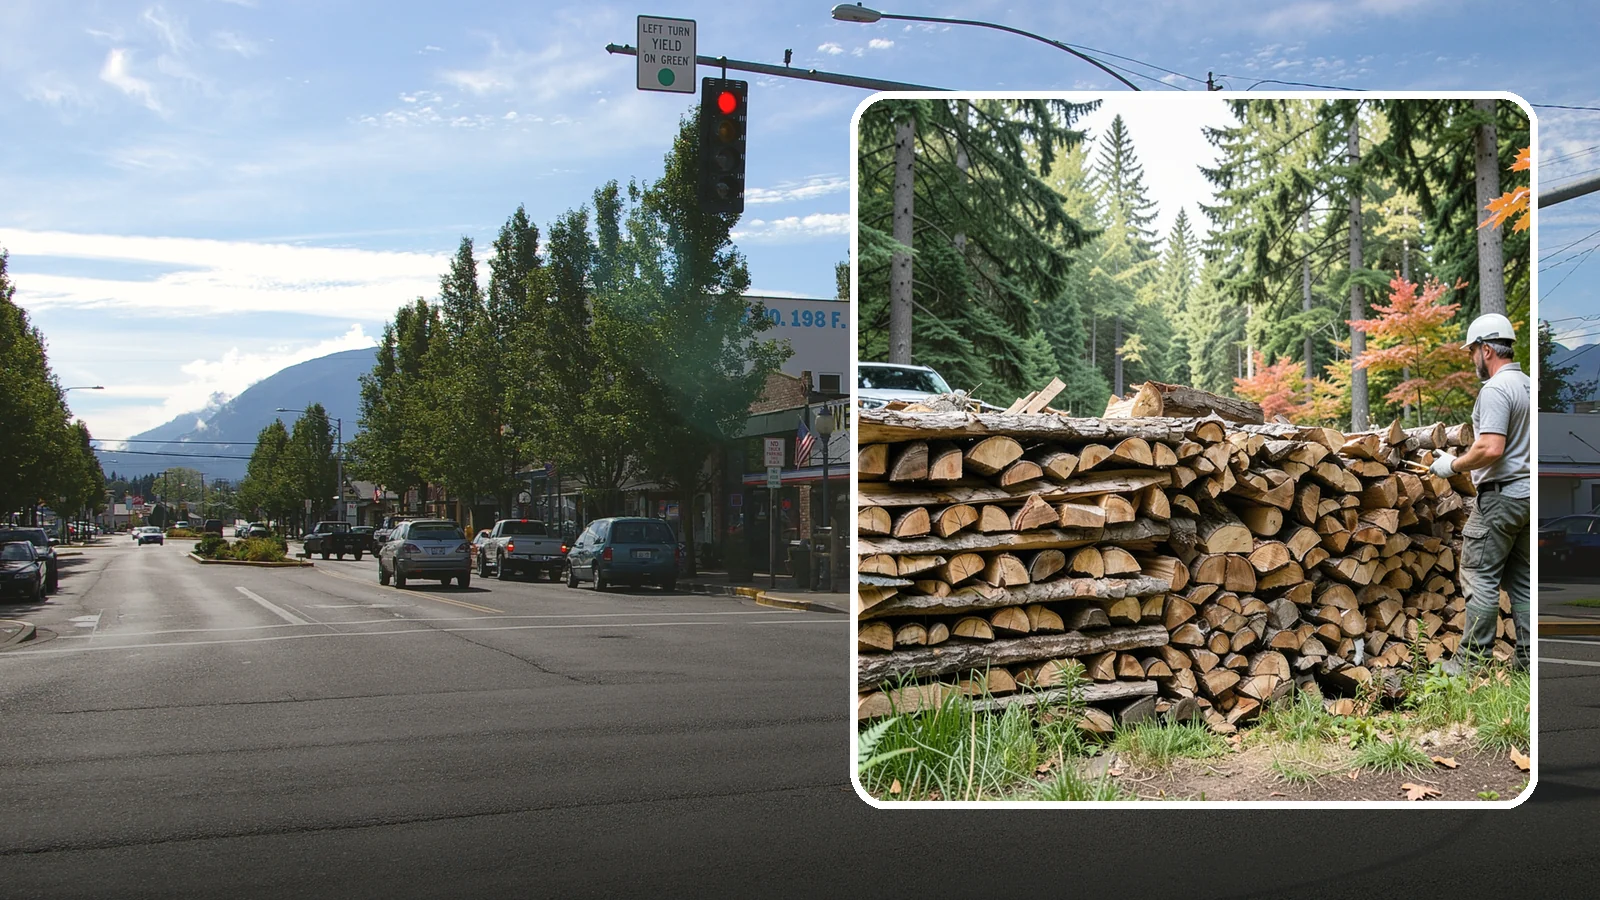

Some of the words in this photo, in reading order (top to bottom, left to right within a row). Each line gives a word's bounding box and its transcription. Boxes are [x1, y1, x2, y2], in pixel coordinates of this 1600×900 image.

[642, 23, 663, 34] LEFT
[668, 26, 690, 36] TURN
[652, 38, 682, 51] YIELD
[644, 53, 656, 63] ON
[661, 54, 689, 66] GREEN
[791, 309, 826, 328] 198
[831, 311, 847, 329] F.
